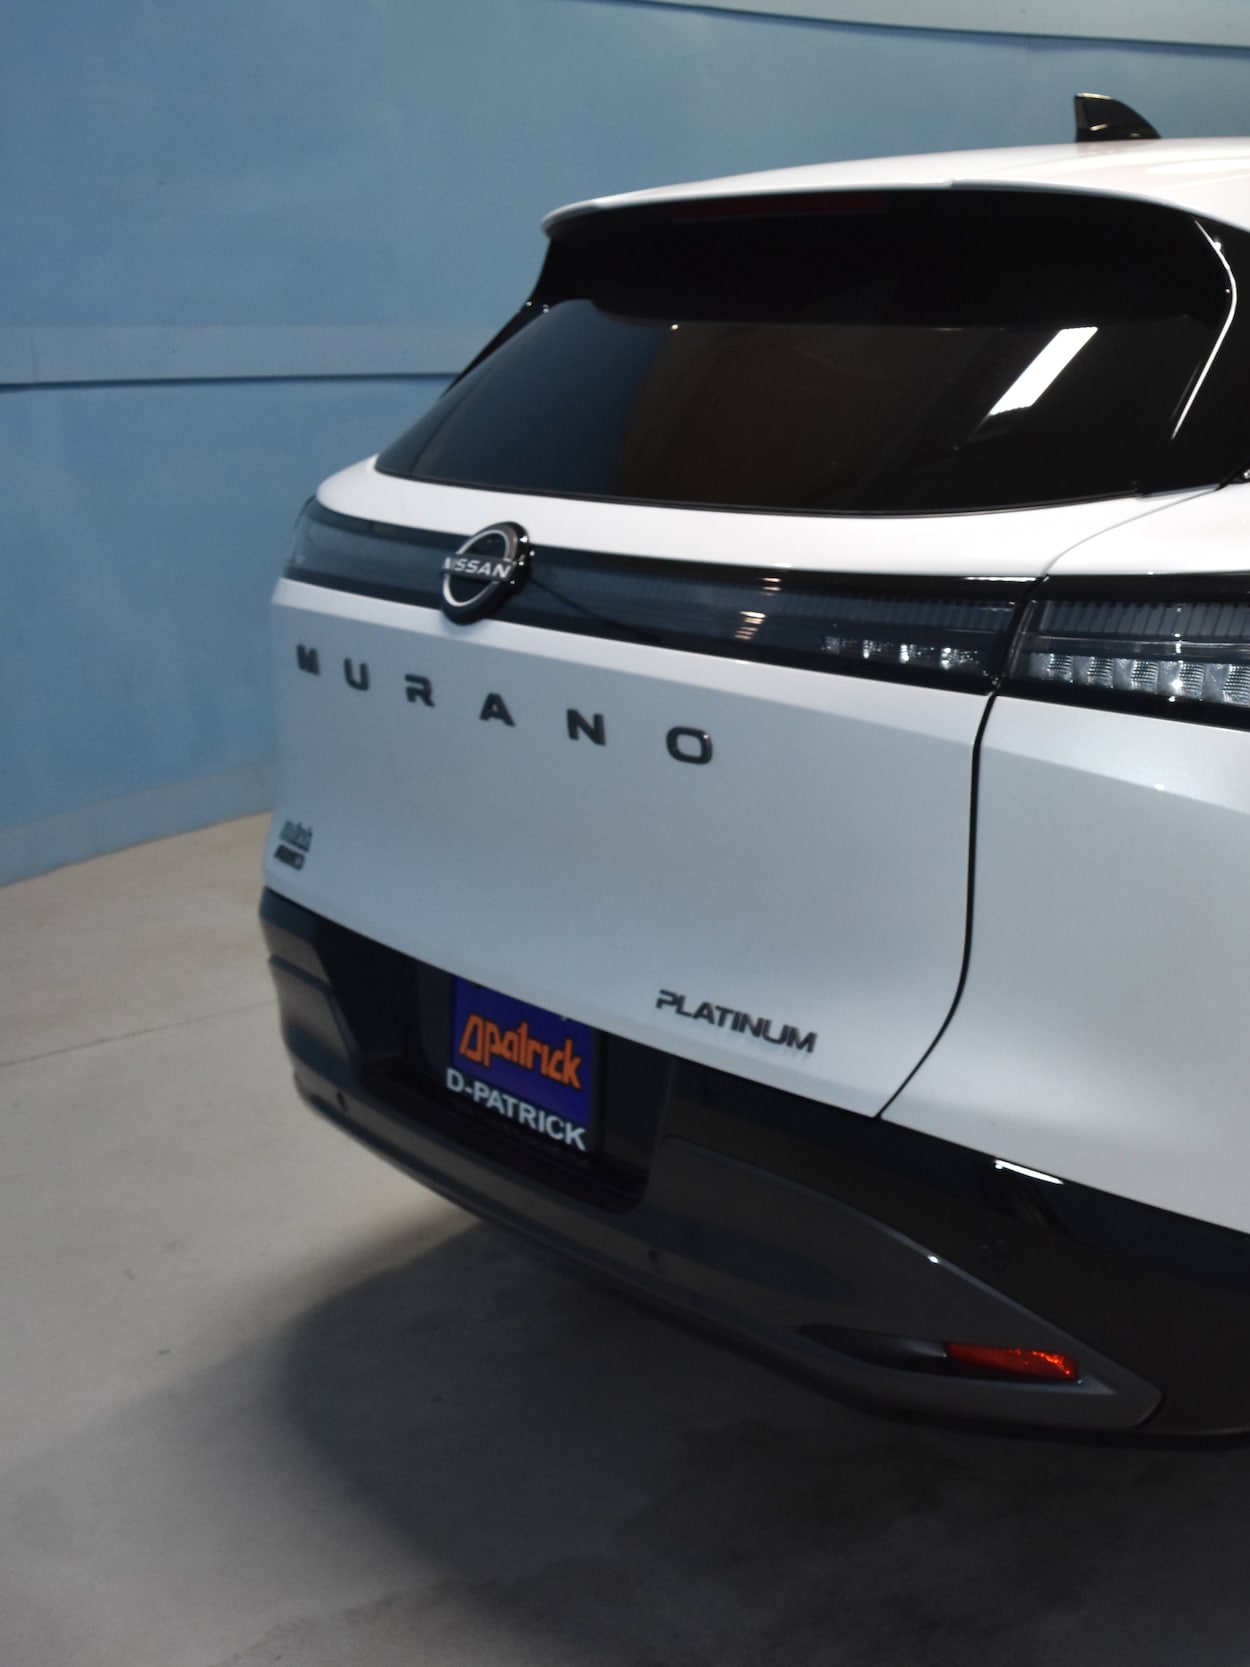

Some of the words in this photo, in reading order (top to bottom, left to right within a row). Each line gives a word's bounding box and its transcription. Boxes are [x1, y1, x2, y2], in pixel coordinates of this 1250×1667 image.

[296, 643, 713, 765] MURANO
[655, 988, 818, 1053] PLATINUM
[446, 1067, 587, 1151] D-PATRICK
